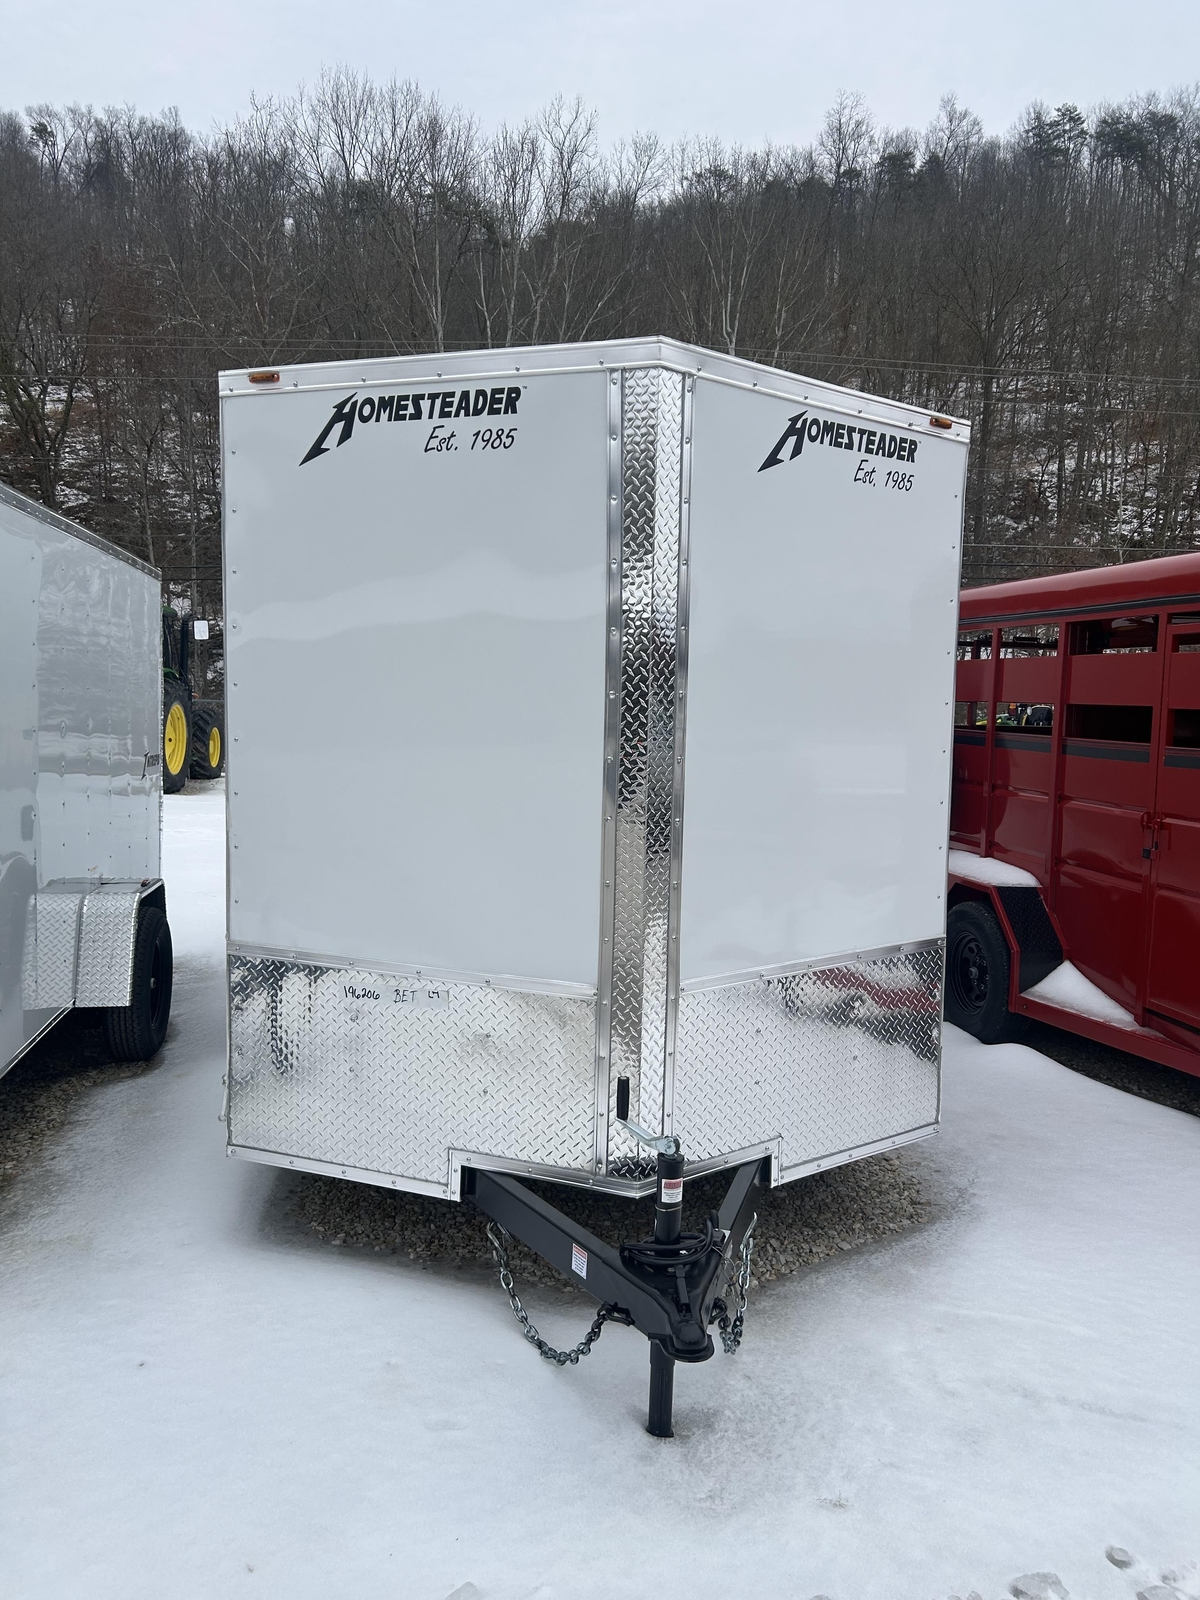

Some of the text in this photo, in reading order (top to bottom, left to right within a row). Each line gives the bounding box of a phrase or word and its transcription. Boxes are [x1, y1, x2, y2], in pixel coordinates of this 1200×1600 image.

[299, 386, 522, 466] HOMESTEADER
[424, 425, 518, 453] Est. 1985
[757, 409, 918, 473] HOMESTEADER
[853, 459, 915, 491] Est. 1985
[343, 985, 381, 1000] 196206
[393, 988, 418, 1004] BET
